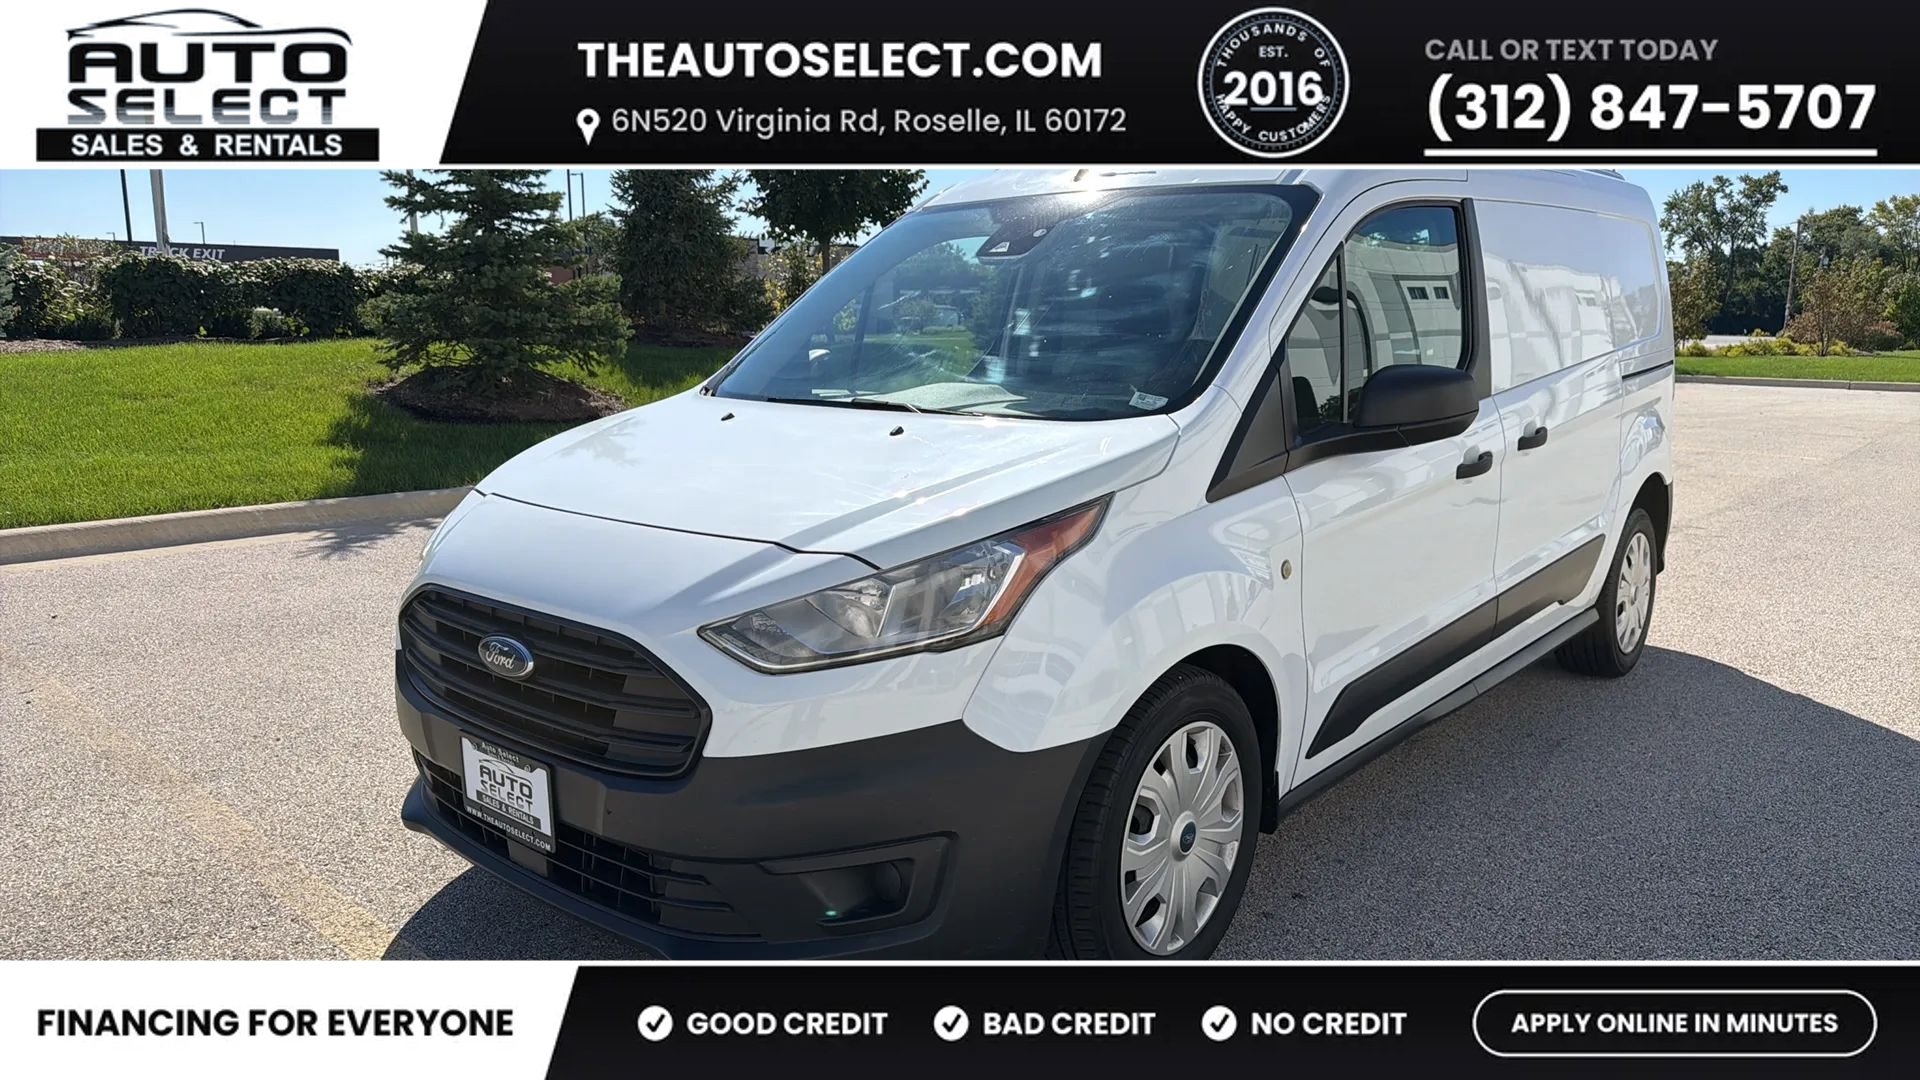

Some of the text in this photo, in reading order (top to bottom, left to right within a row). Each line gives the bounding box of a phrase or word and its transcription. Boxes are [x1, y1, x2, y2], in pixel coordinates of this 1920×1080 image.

[193, 248, 226, 259] EXIT
[486, 641, 516, 669] Ford
[481, 741, 497, 754] Auto
[497, 748, 519, 762] Select
[480, 764, 533, 799] AUTO
[480, 779, 534, 813] SELECT
[481, 794, 500, 809] SALES
[508, 805, 534, 825] RENTALS
[465, 805, 551, 850] WWW.THEAUTOSELECT.COM
